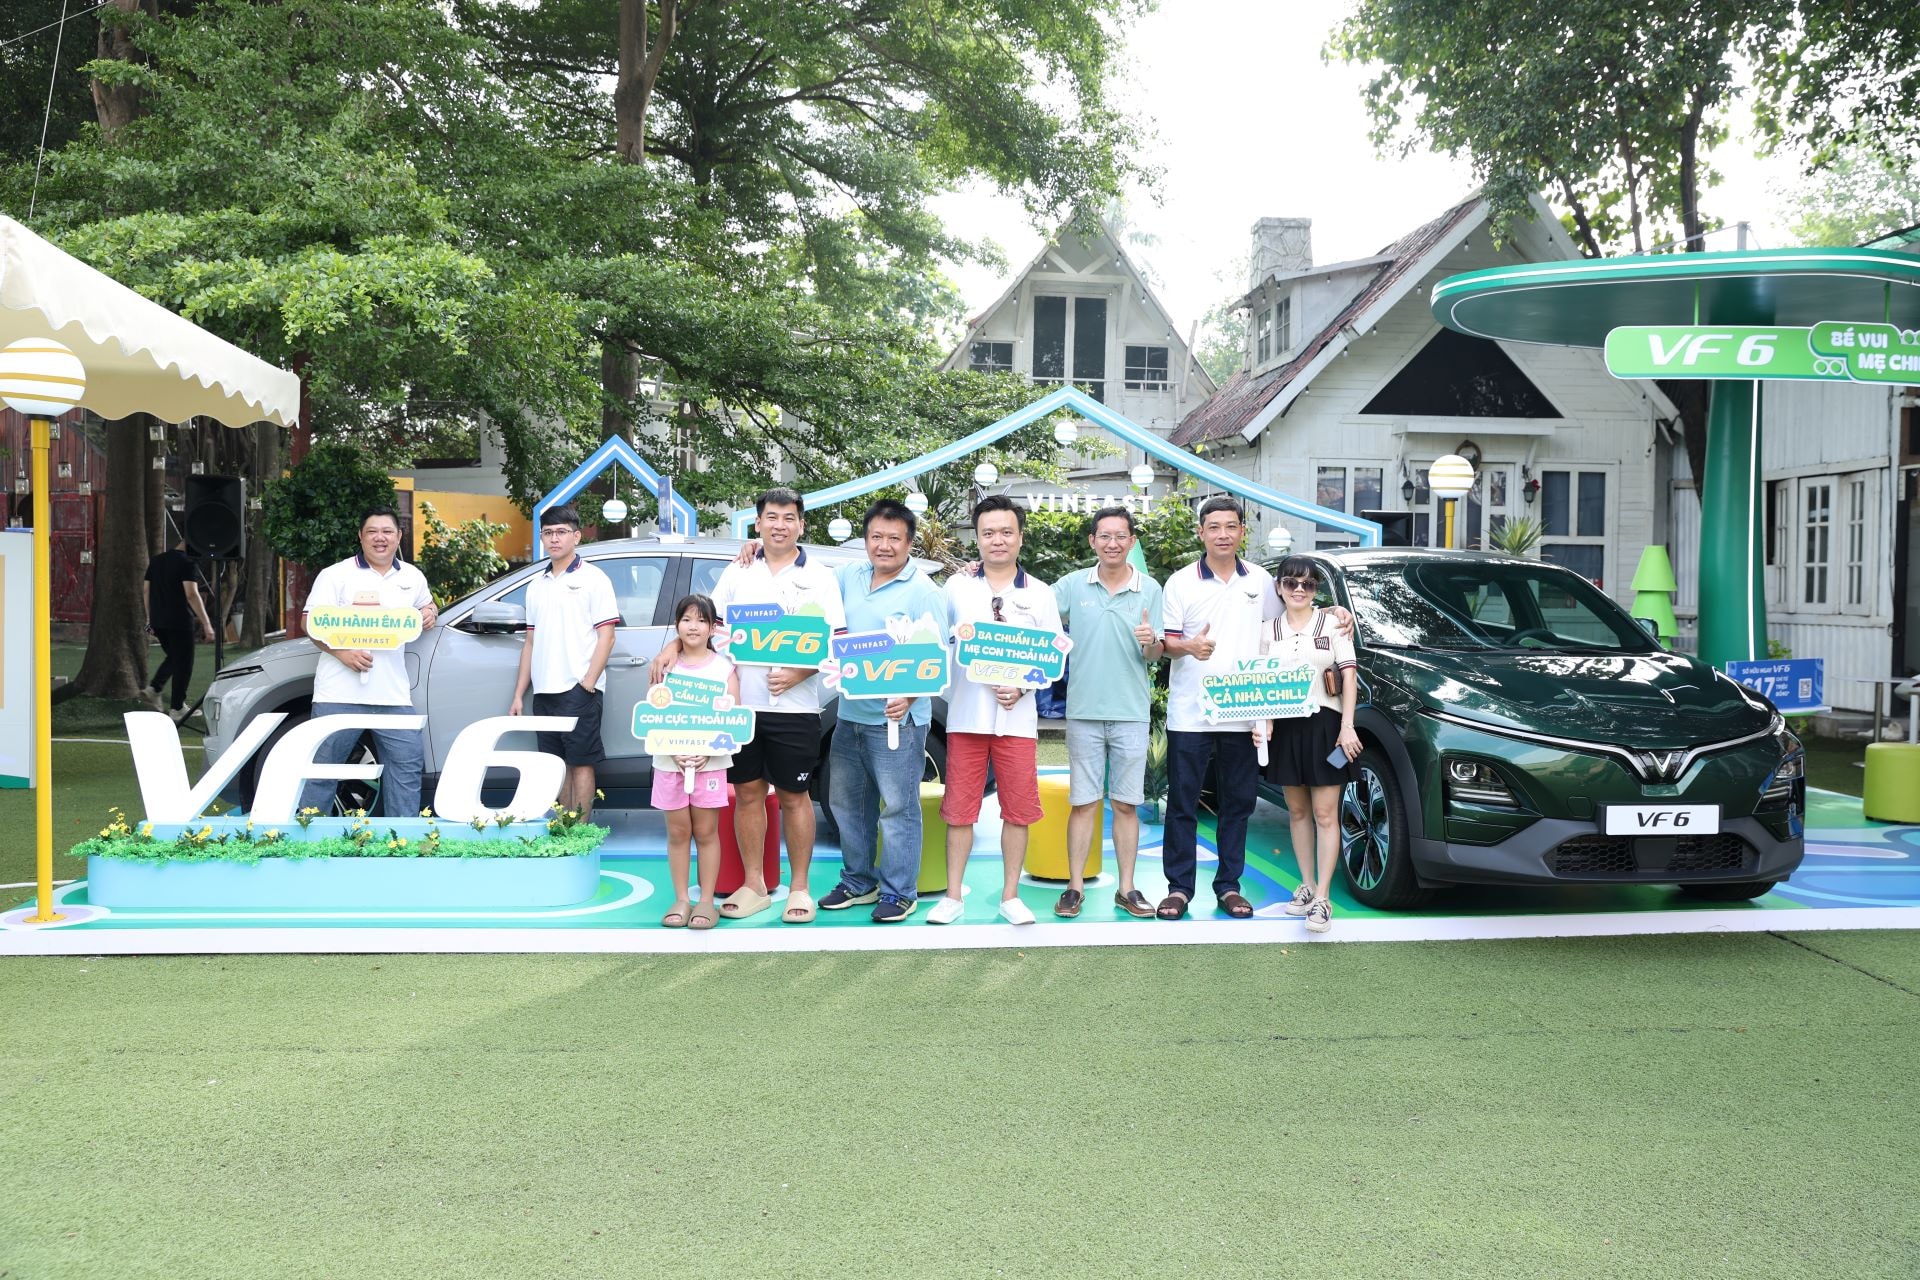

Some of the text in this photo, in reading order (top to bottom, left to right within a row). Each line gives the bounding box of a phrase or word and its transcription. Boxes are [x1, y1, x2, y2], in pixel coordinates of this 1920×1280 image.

[1830, 327, 1888, 348] BÉ VUI
[1648, 334, 1778, 366] VF 6
[1858, 353, 1920, 375] MẸ CHI
[313, 614, 417, 630] VẬN HÀNH ÊM ÁI
[744, 609, 779, 618] VINFAST
[852, 639, 889, 650] VINFAST
[977, 630, 1049, 648] BA CHUẨN LÁI
[964, 643, 1059, 664] MẸ CON THOẢI MÁI
[863, 659, 942, 682] VF 6
[1237, 657, 1281, 671] VF 6
[1203, 664, 1316, 687] GLAMPING CHẤT
[1213, 687, 1307, 705] CẢ NHÀ CHILL
[640, 711, 748, 727] CON CỰC THOẢI MÁI
[123, 711, 579, 825] VF 6
[1637, 811, 1691, 827] VF 6
